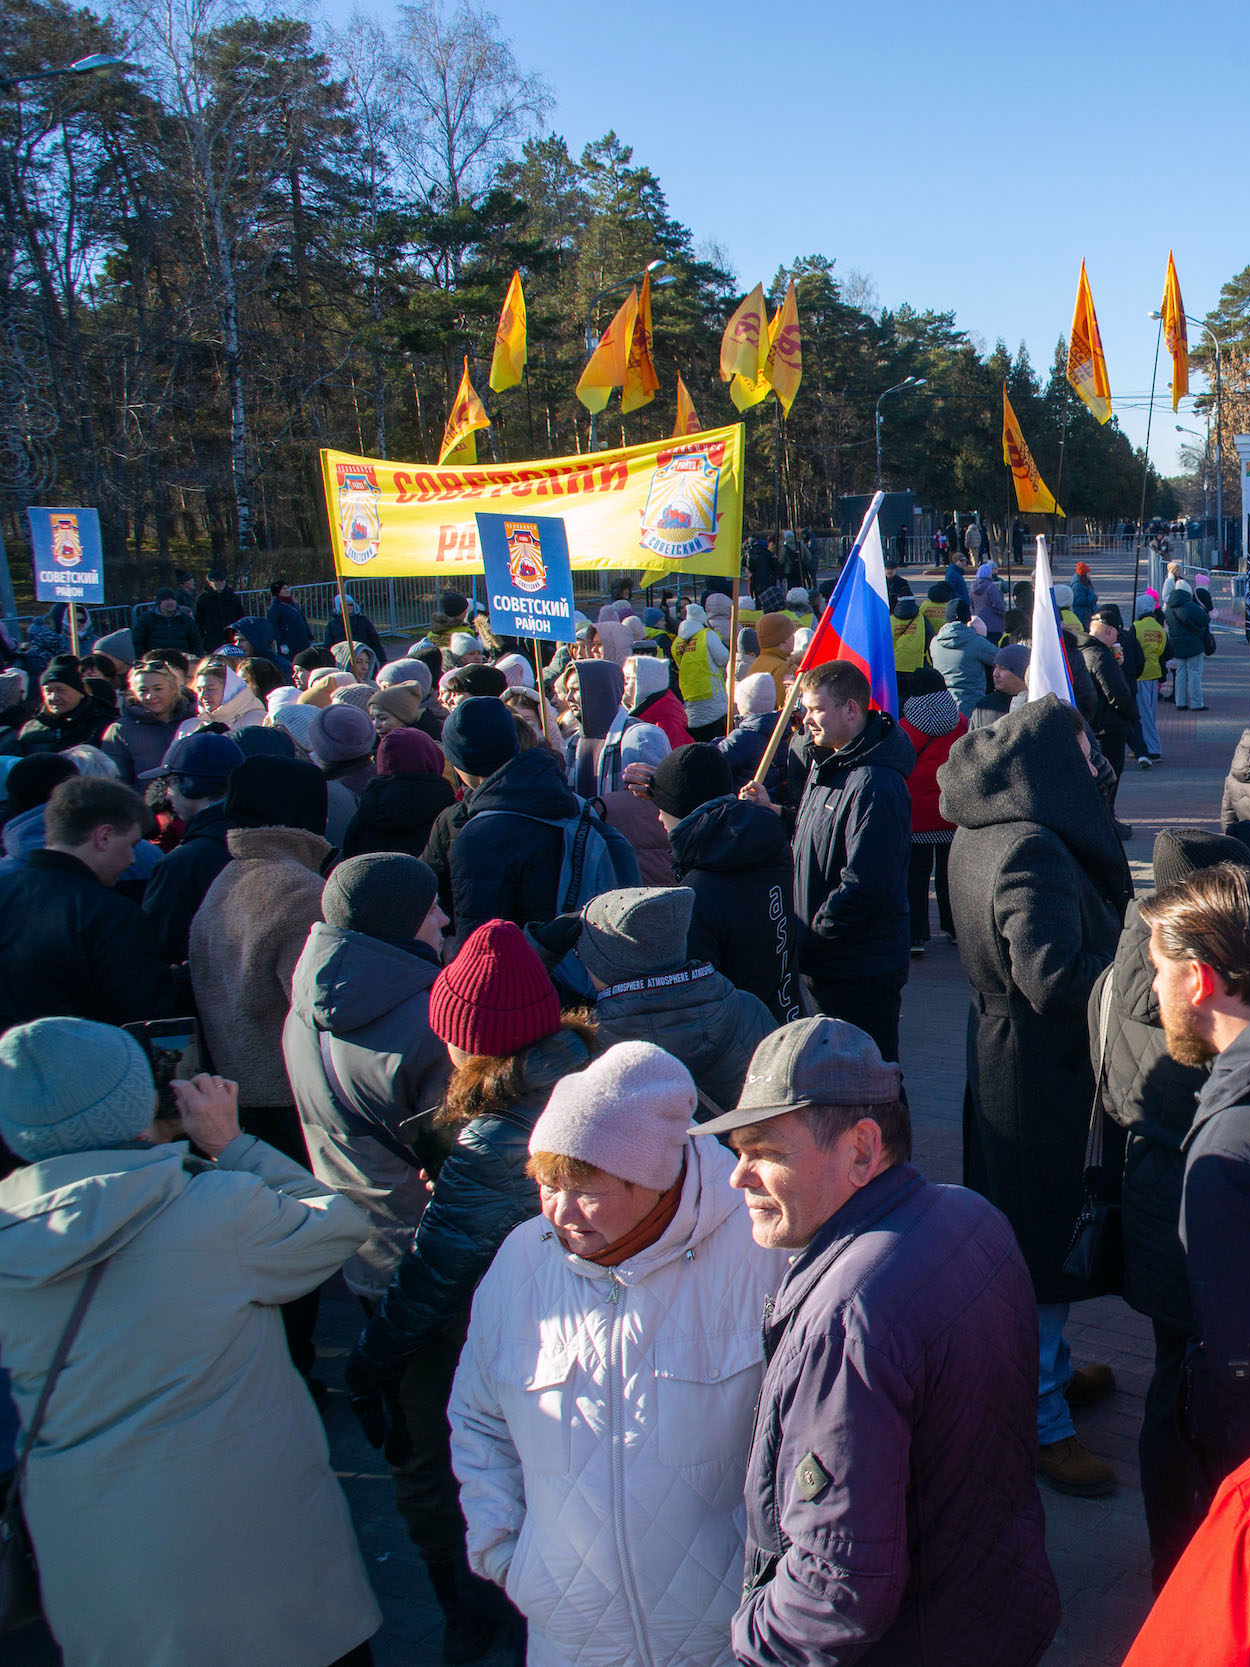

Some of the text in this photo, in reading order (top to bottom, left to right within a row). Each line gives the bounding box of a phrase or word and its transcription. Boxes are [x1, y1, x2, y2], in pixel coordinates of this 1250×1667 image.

[393, 454, 628, 503] СОВЕТСКИЙ
[648, 537, 703, 555] СОВЕТСКИЙ
[39, 569, 99, 584] СОВЕТСКИЙ
[56, 585, 84, 597] РАЙОН
[493, 595, 570, 618] СОВЕТСКИЙ
[515, 616, 551, 633] РАЙОН
[612, 979, 645, 996] ATMOSPHERE
[647, 972, 689, 988] ATMOSPHERE
